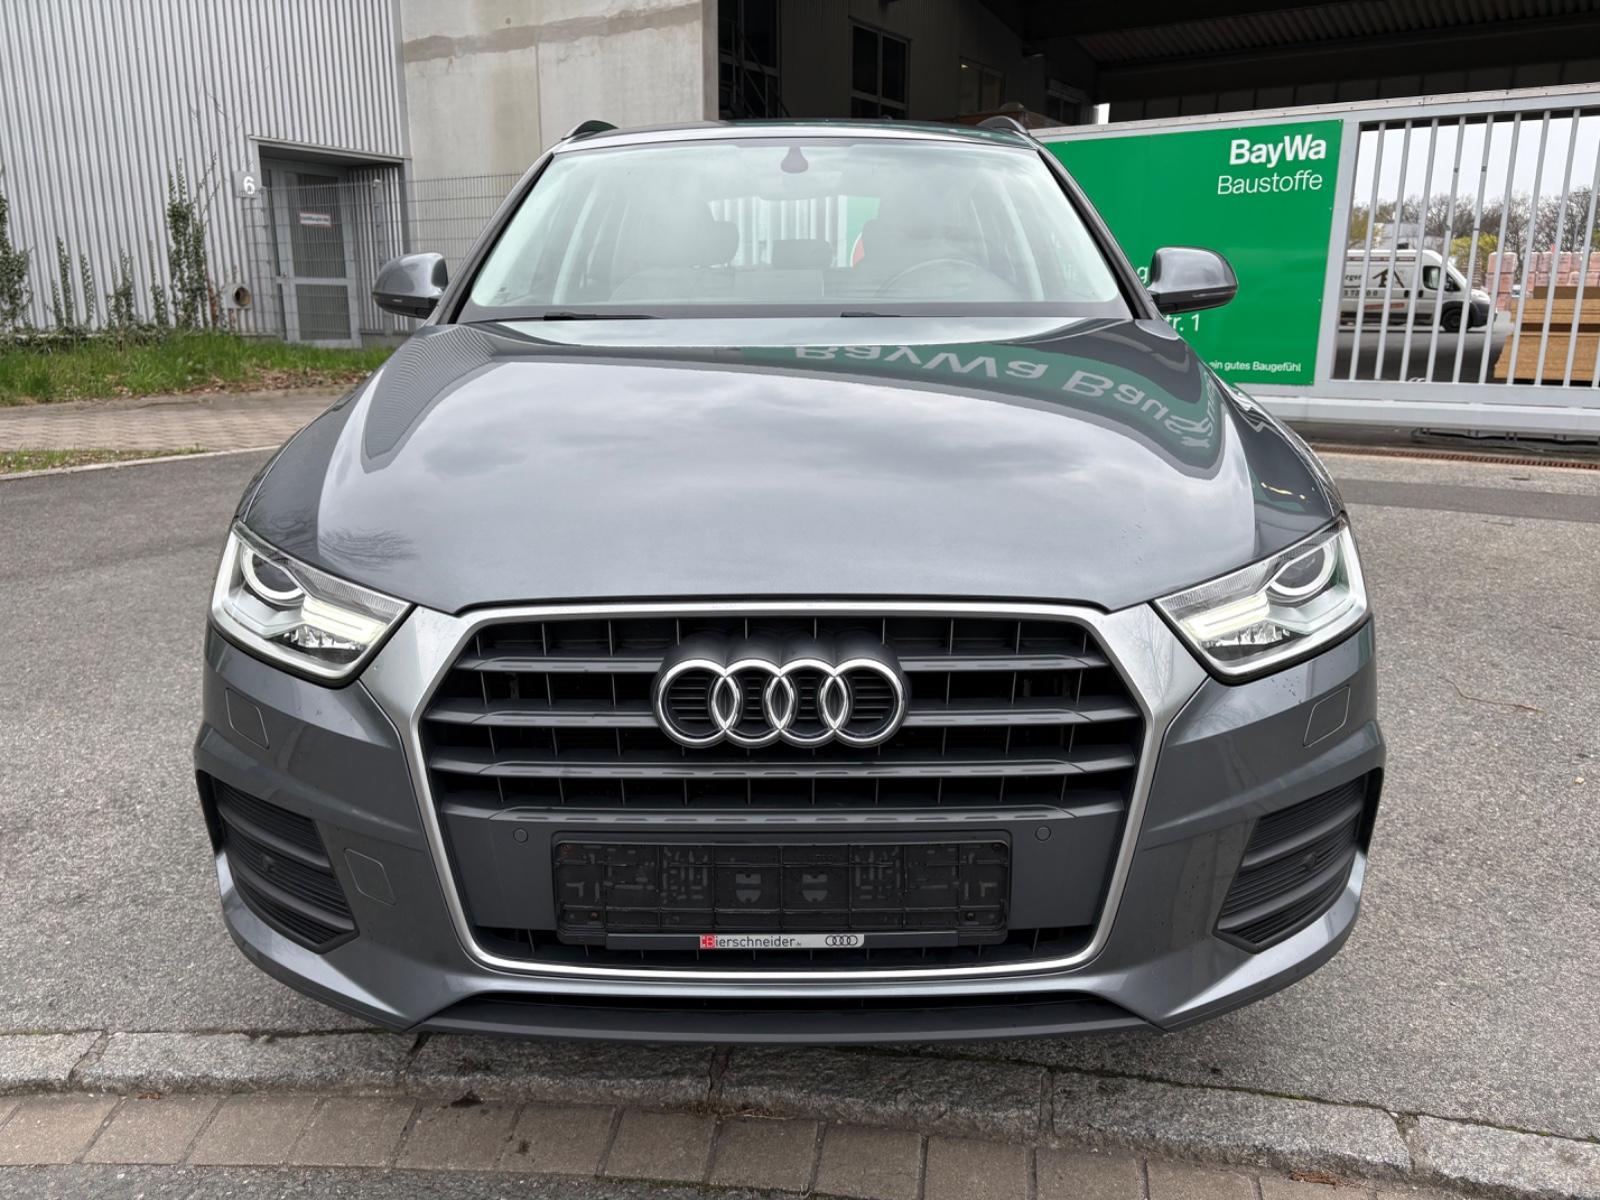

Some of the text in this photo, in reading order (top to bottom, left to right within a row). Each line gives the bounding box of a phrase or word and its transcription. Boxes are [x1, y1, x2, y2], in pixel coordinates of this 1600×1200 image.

[1229, 133, 1327, 168] BayWa
[243, 175, 256, 195] 6
[1218, 169, 1323, 195] Baustoffe
[1191, 313, 1199, 332] 1
[1224, 361, 1251, 371] gutes
[1252, 360, 1302, 373] Baugefühl
